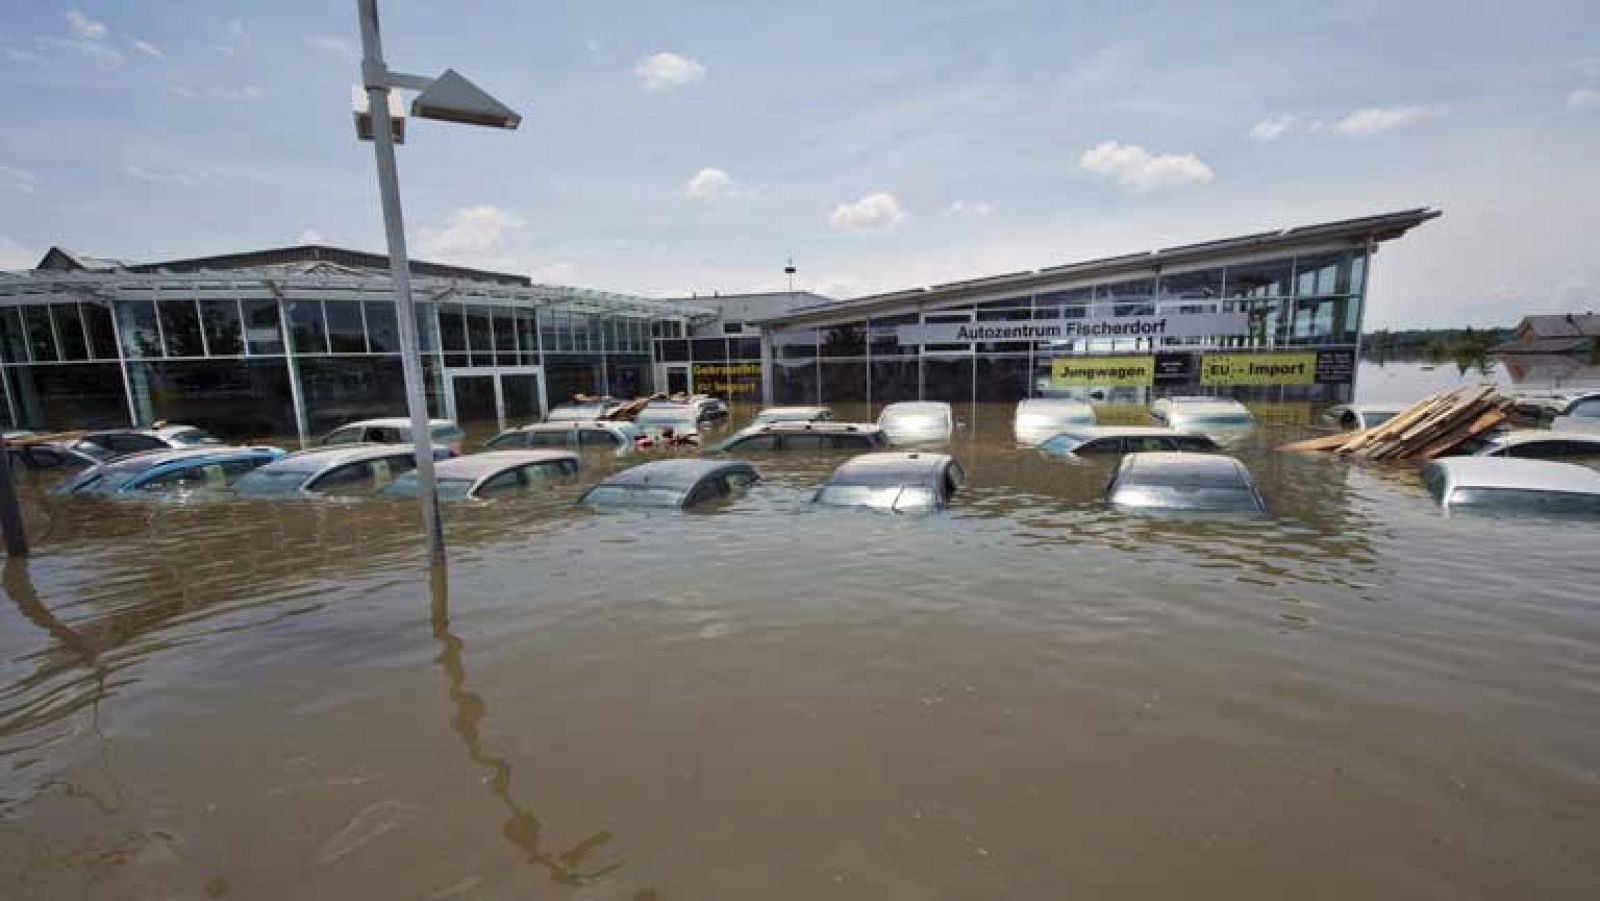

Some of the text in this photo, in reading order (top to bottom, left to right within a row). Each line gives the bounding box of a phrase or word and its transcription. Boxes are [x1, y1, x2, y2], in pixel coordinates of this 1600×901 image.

[957, 318, 1167, 339] Autozentrum Fischerdorf
[1060, 366, 1145, 380] Jungwagen
[1210, 365, 1230, 376] EU
[1249, 362, 1304, 378] Import
